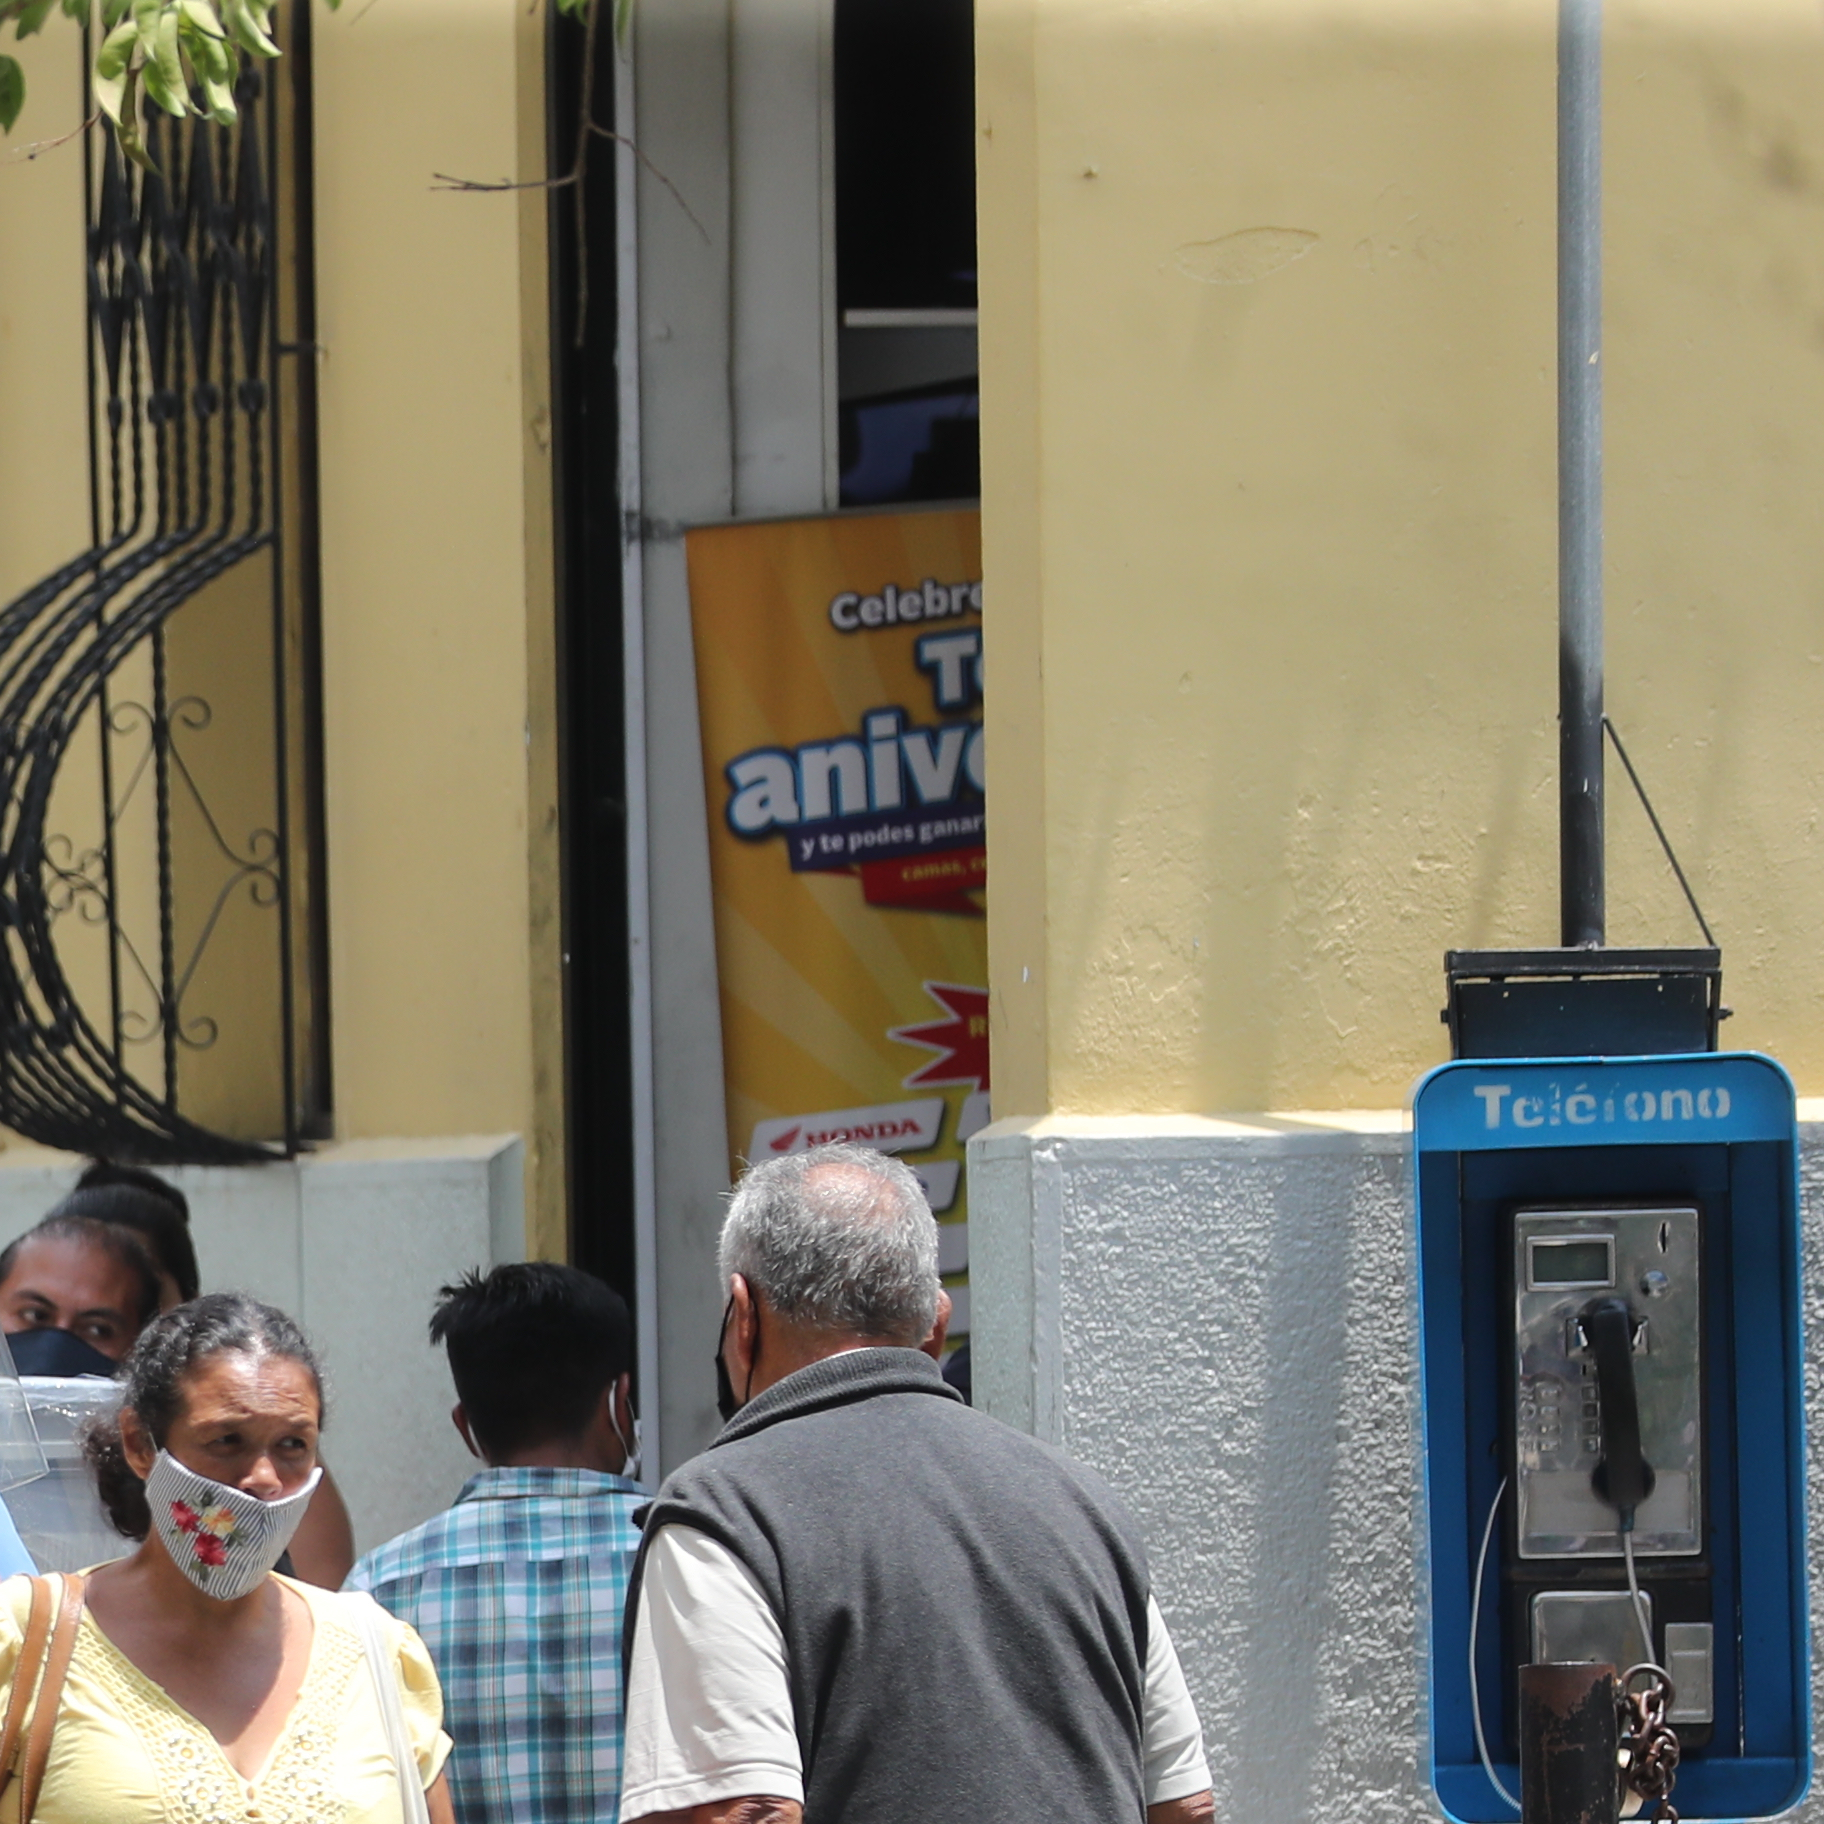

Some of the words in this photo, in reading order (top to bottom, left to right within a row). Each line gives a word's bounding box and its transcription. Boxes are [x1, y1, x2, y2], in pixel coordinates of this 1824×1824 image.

[919, 634, 984, 704] T
[801, 837, 815, 861] y
[819, 833, 845, 854] te
[849, 823, 915, 855] podes
[806, 1118, 922, 1148] HONDA
